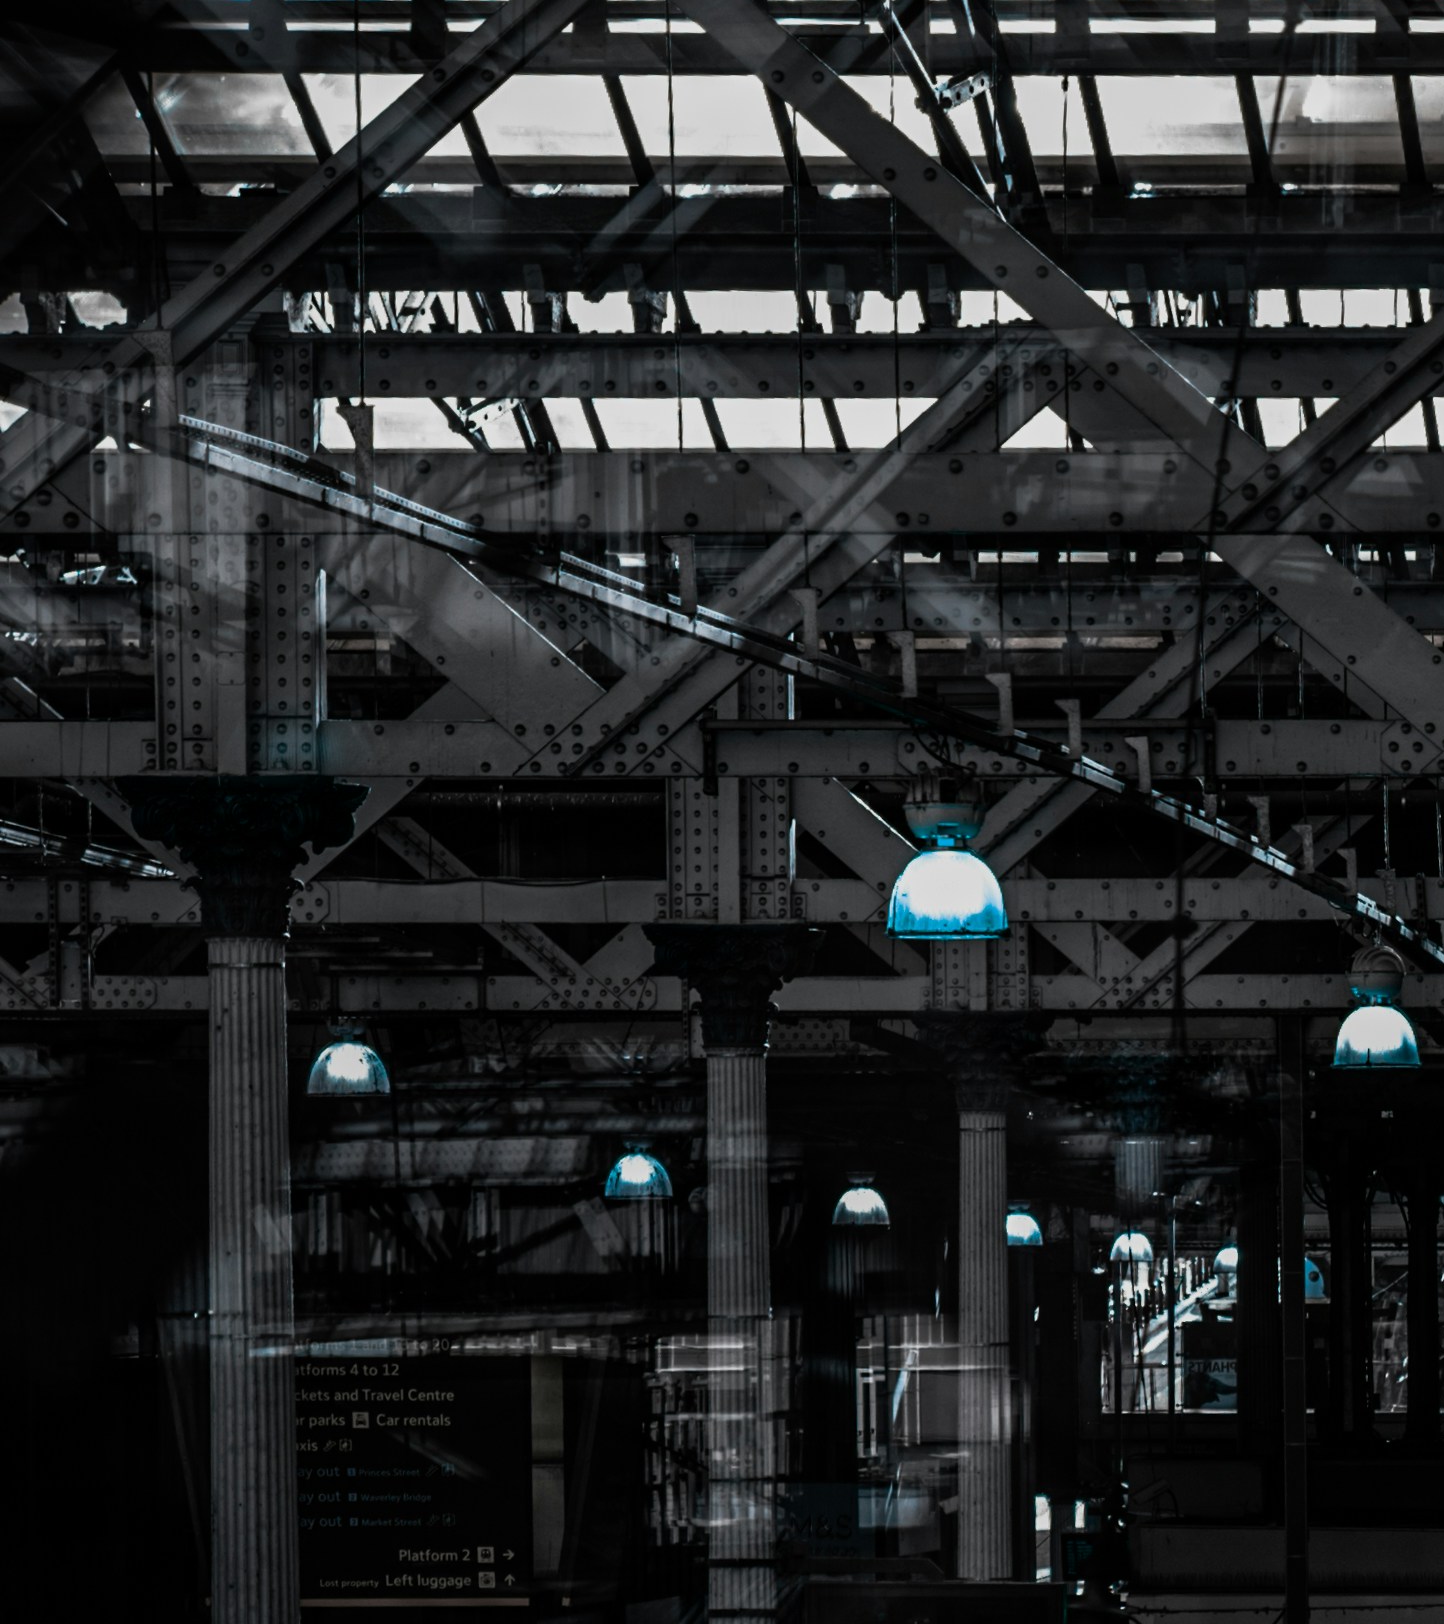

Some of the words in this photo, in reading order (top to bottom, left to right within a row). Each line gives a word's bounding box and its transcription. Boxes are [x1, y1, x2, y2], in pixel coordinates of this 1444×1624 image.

[431, 1337, 450, 1351] 20
[350, 1365, 359, 1376] 4
[362, 1365, 379, 1377] to
[383, 1363, 400, 1376] 12
[334, 1388, 359, 1402] and
[362, 1388, 404, 1402] Travel
[407, 1388, 456, 1402] Centre
[308, 1413, 346, 1429] parks
[376, 1413, 400, 1427] Car
[403, 1413, 452, 1427] rentals
[316, 1466, 341, 1478] out
[358, 1467, 391, 1477] Princes
[392, 1466, 421, 1477] Street
[318, 1490, 342, 1503] out
[361, 1492, 401, 1505] Waverley
[402, 1491, 433, 1505] Bridge
[319, 1514, 343, 1528] out
[361, 1516, 392, 1527] Market
[393, 1516, 422, 1528] Street
[399, 1548, 459, 1563] Platform
[461, 1548, 471, 1562] 2
[319, 1578, 340, 1588] Lost
[340, 1578, 380, 1591] property
[385, 1573, 415, 1587] Left
[416, 1573, 472, 1591] luggage
